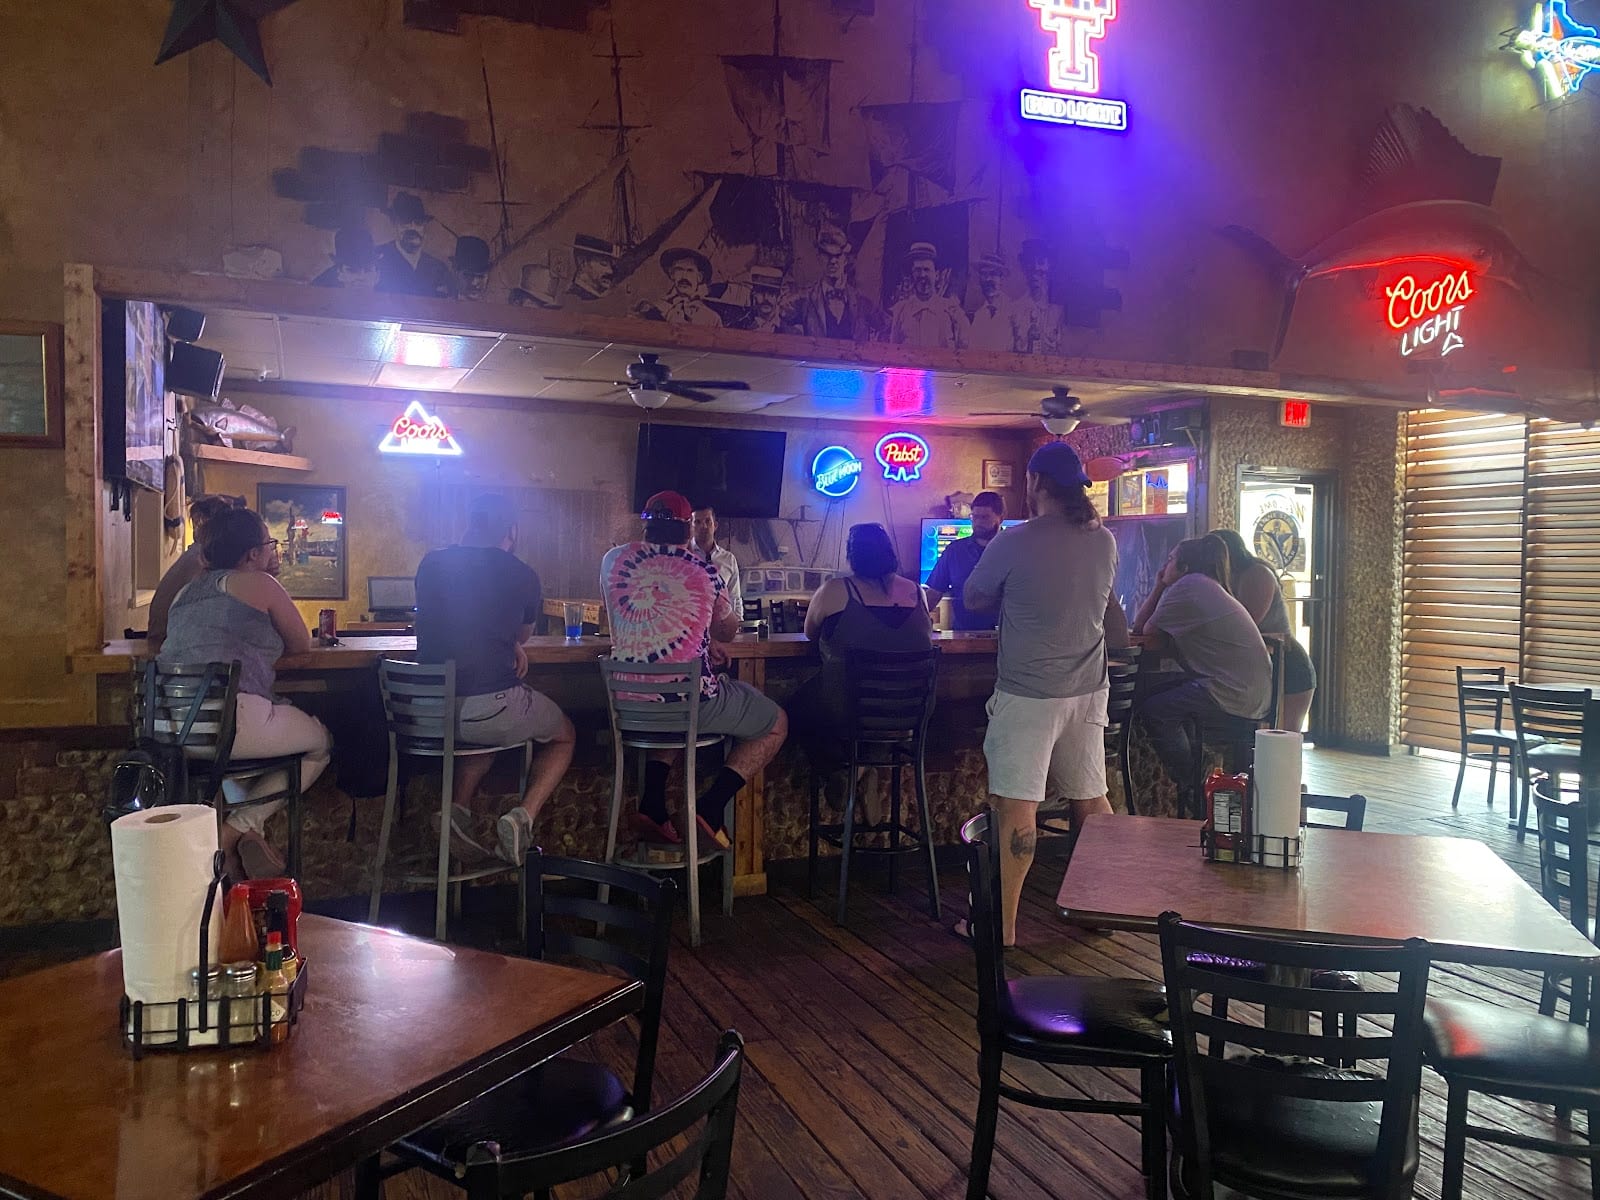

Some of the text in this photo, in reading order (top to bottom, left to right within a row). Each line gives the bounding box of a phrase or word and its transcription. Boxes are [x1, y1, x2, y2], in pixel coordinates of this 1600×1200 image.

[1386, 270, 1473, 328] Coors
[1401, 305, 1465, 356] LIGHT
[392, 416, 451, 440] Coors
[884, 442, 922, 462] Pabst
